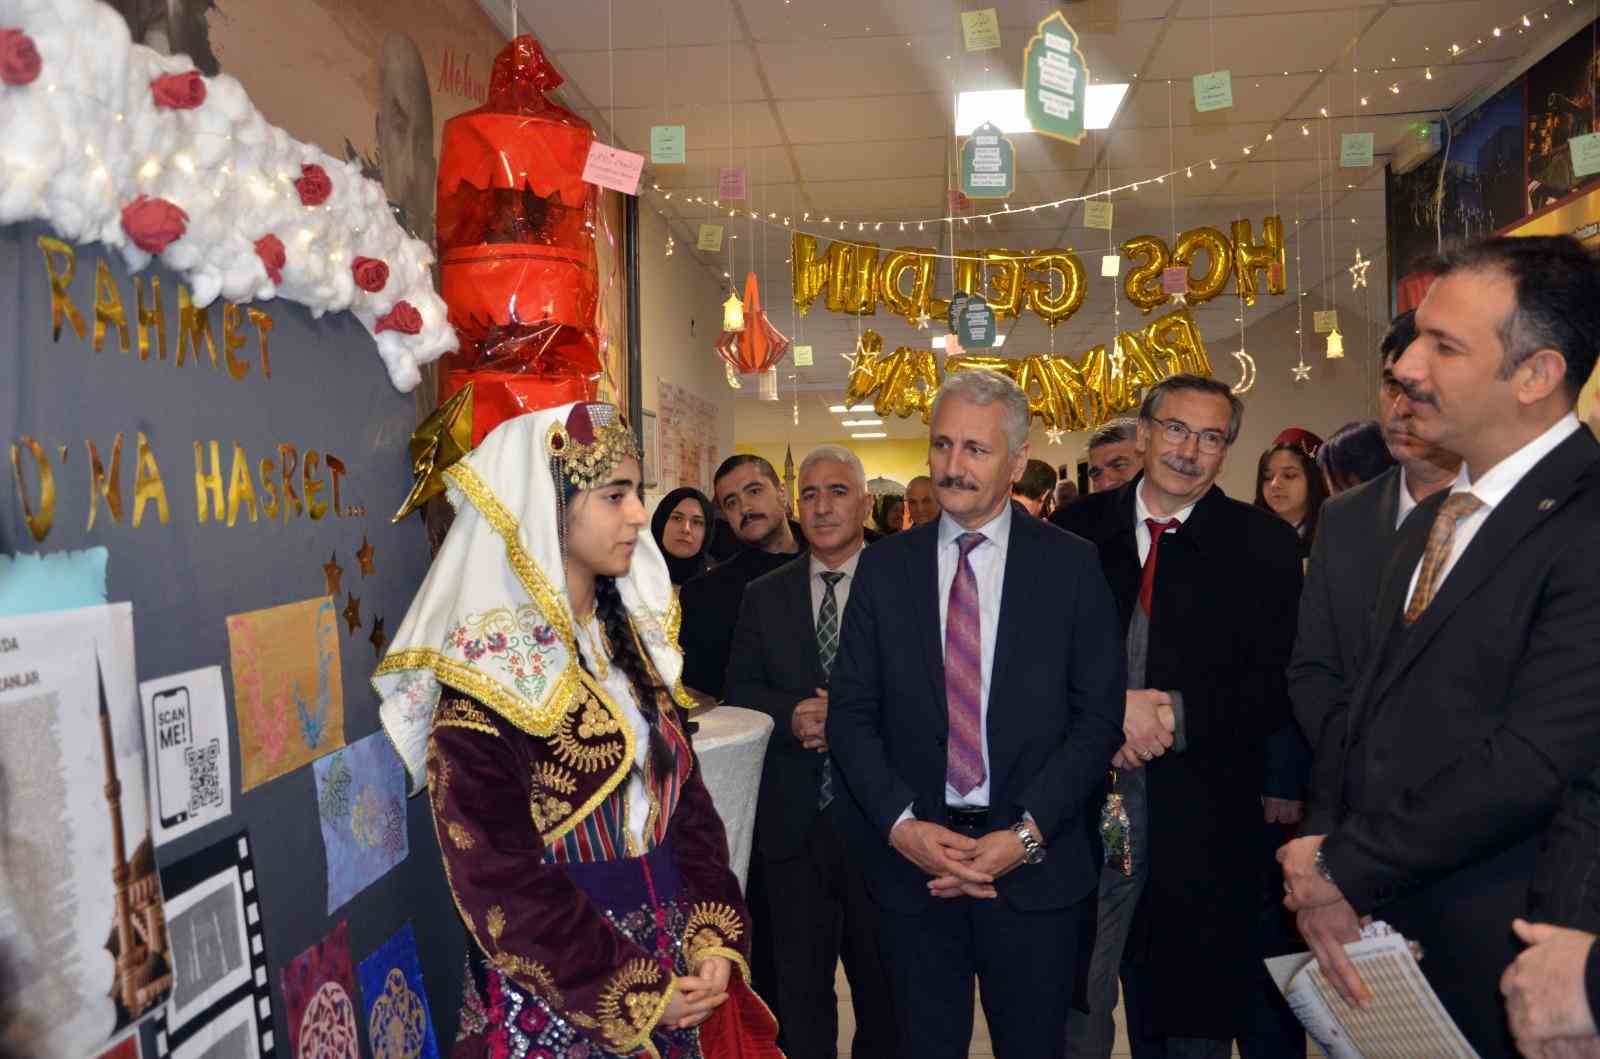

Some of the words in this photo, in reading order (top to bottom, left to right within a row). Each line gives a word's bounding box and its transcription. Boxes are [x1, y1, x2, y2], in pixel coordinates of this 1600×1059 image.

[38, 235, 274, 380] RAHMET
[158, 707, 185, 726] SCAN
[160, 722, 187, 749] ME!
